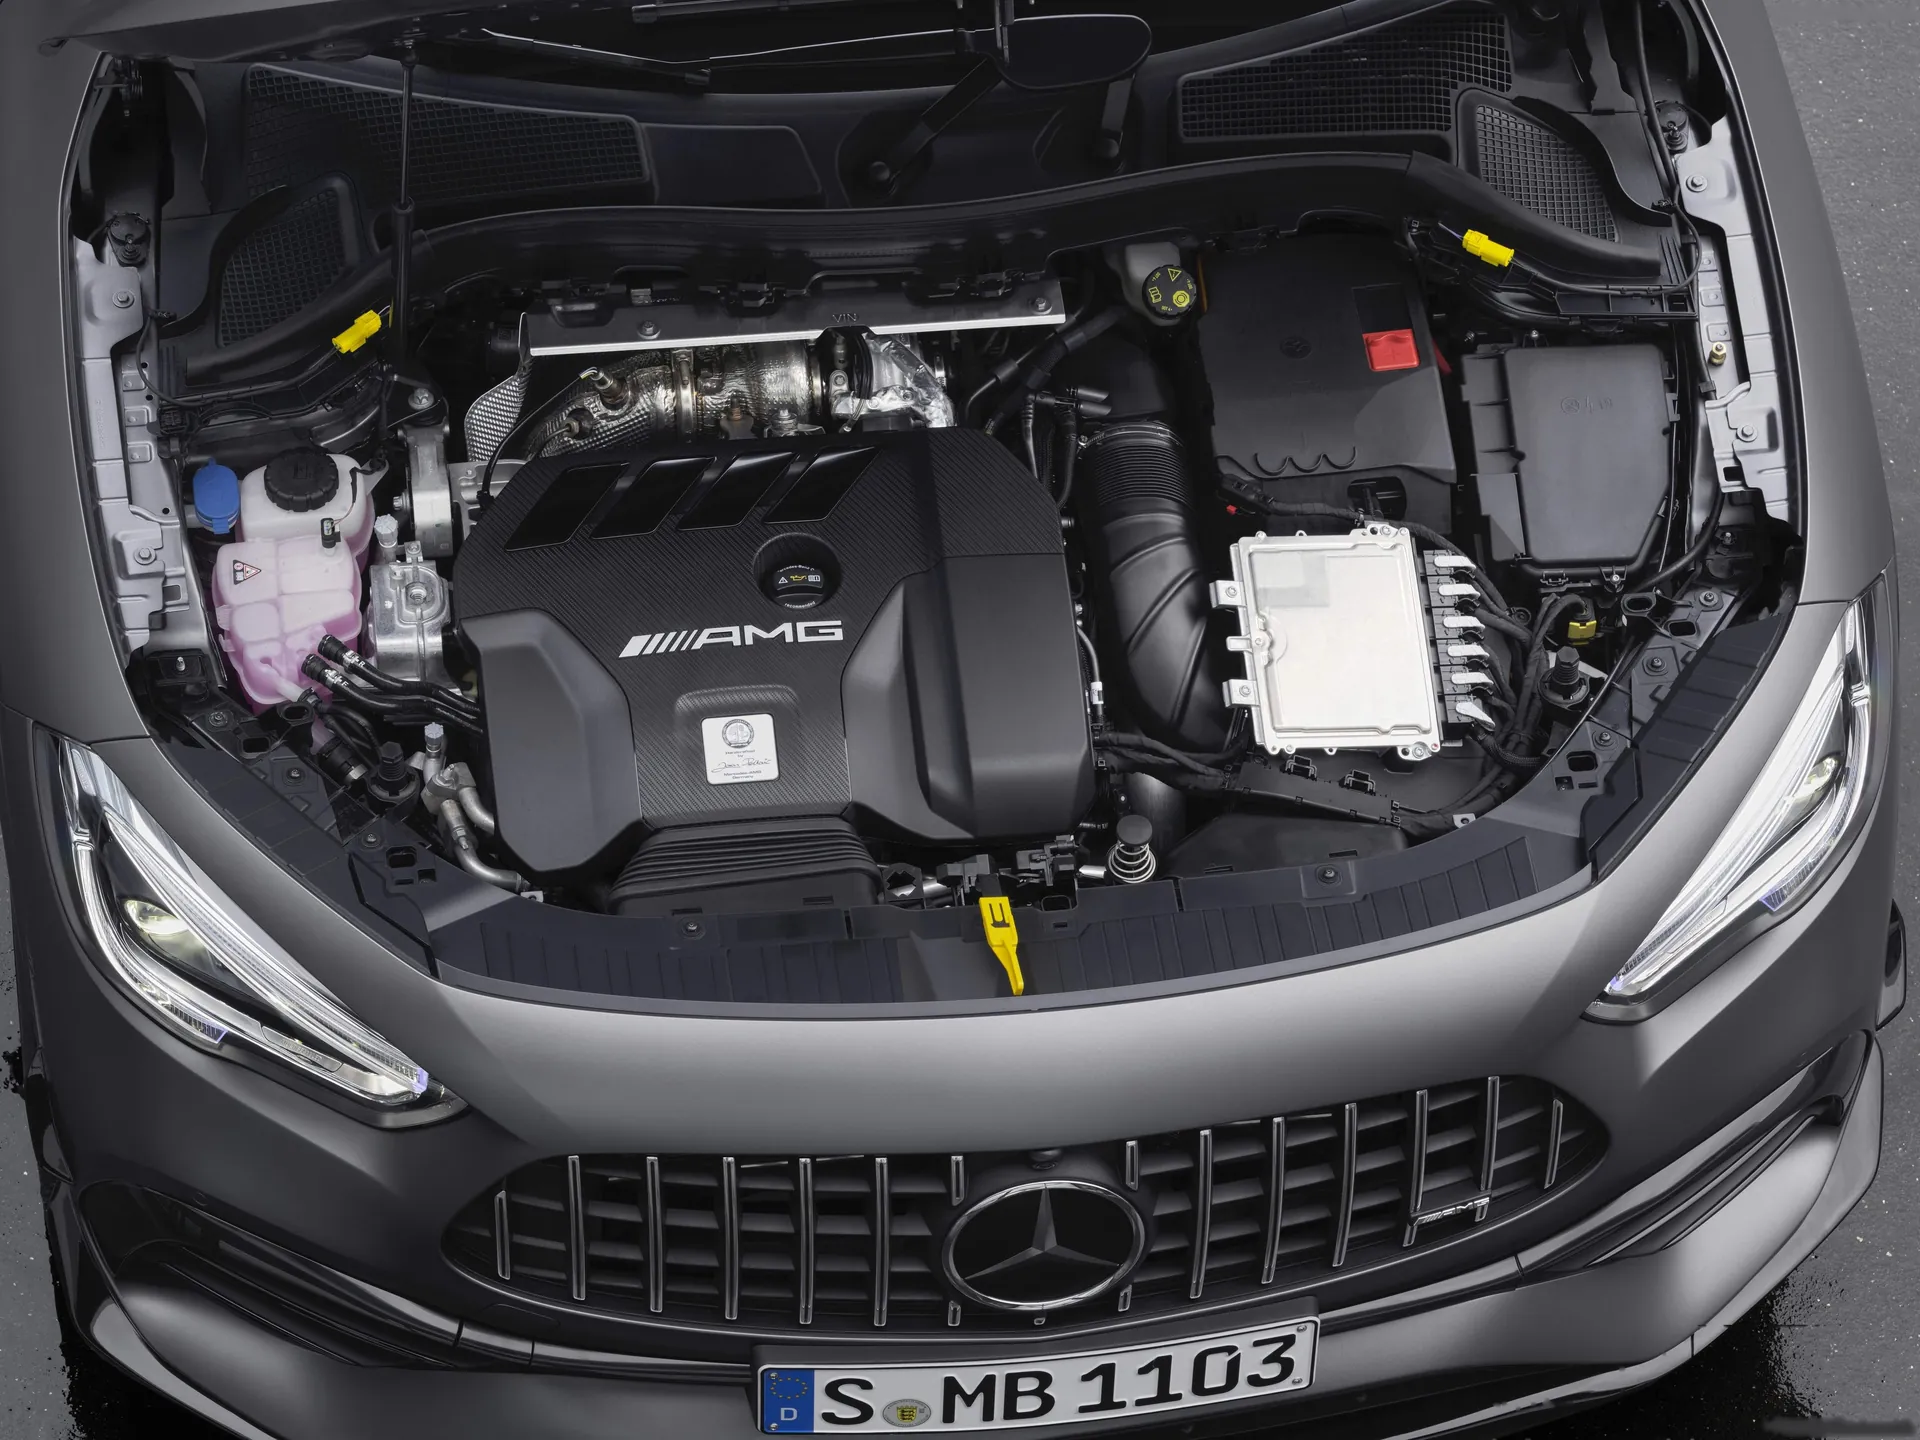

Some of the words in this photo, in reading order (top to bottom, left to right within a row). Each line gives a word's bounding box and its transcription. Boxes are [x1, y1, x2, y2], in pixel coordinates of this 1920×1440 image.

[832, 313, 857, 323] VIN
[691, 620, 844, 650] AMG
[1438, 1197, 1490, 1219] AMG
[820, 1377, 875, 1426] S
[941, 1370, 1056, 1425] MB
[1078, 1334, 1298, 1413] 1103
[780, 1407, 798, 1422] D
